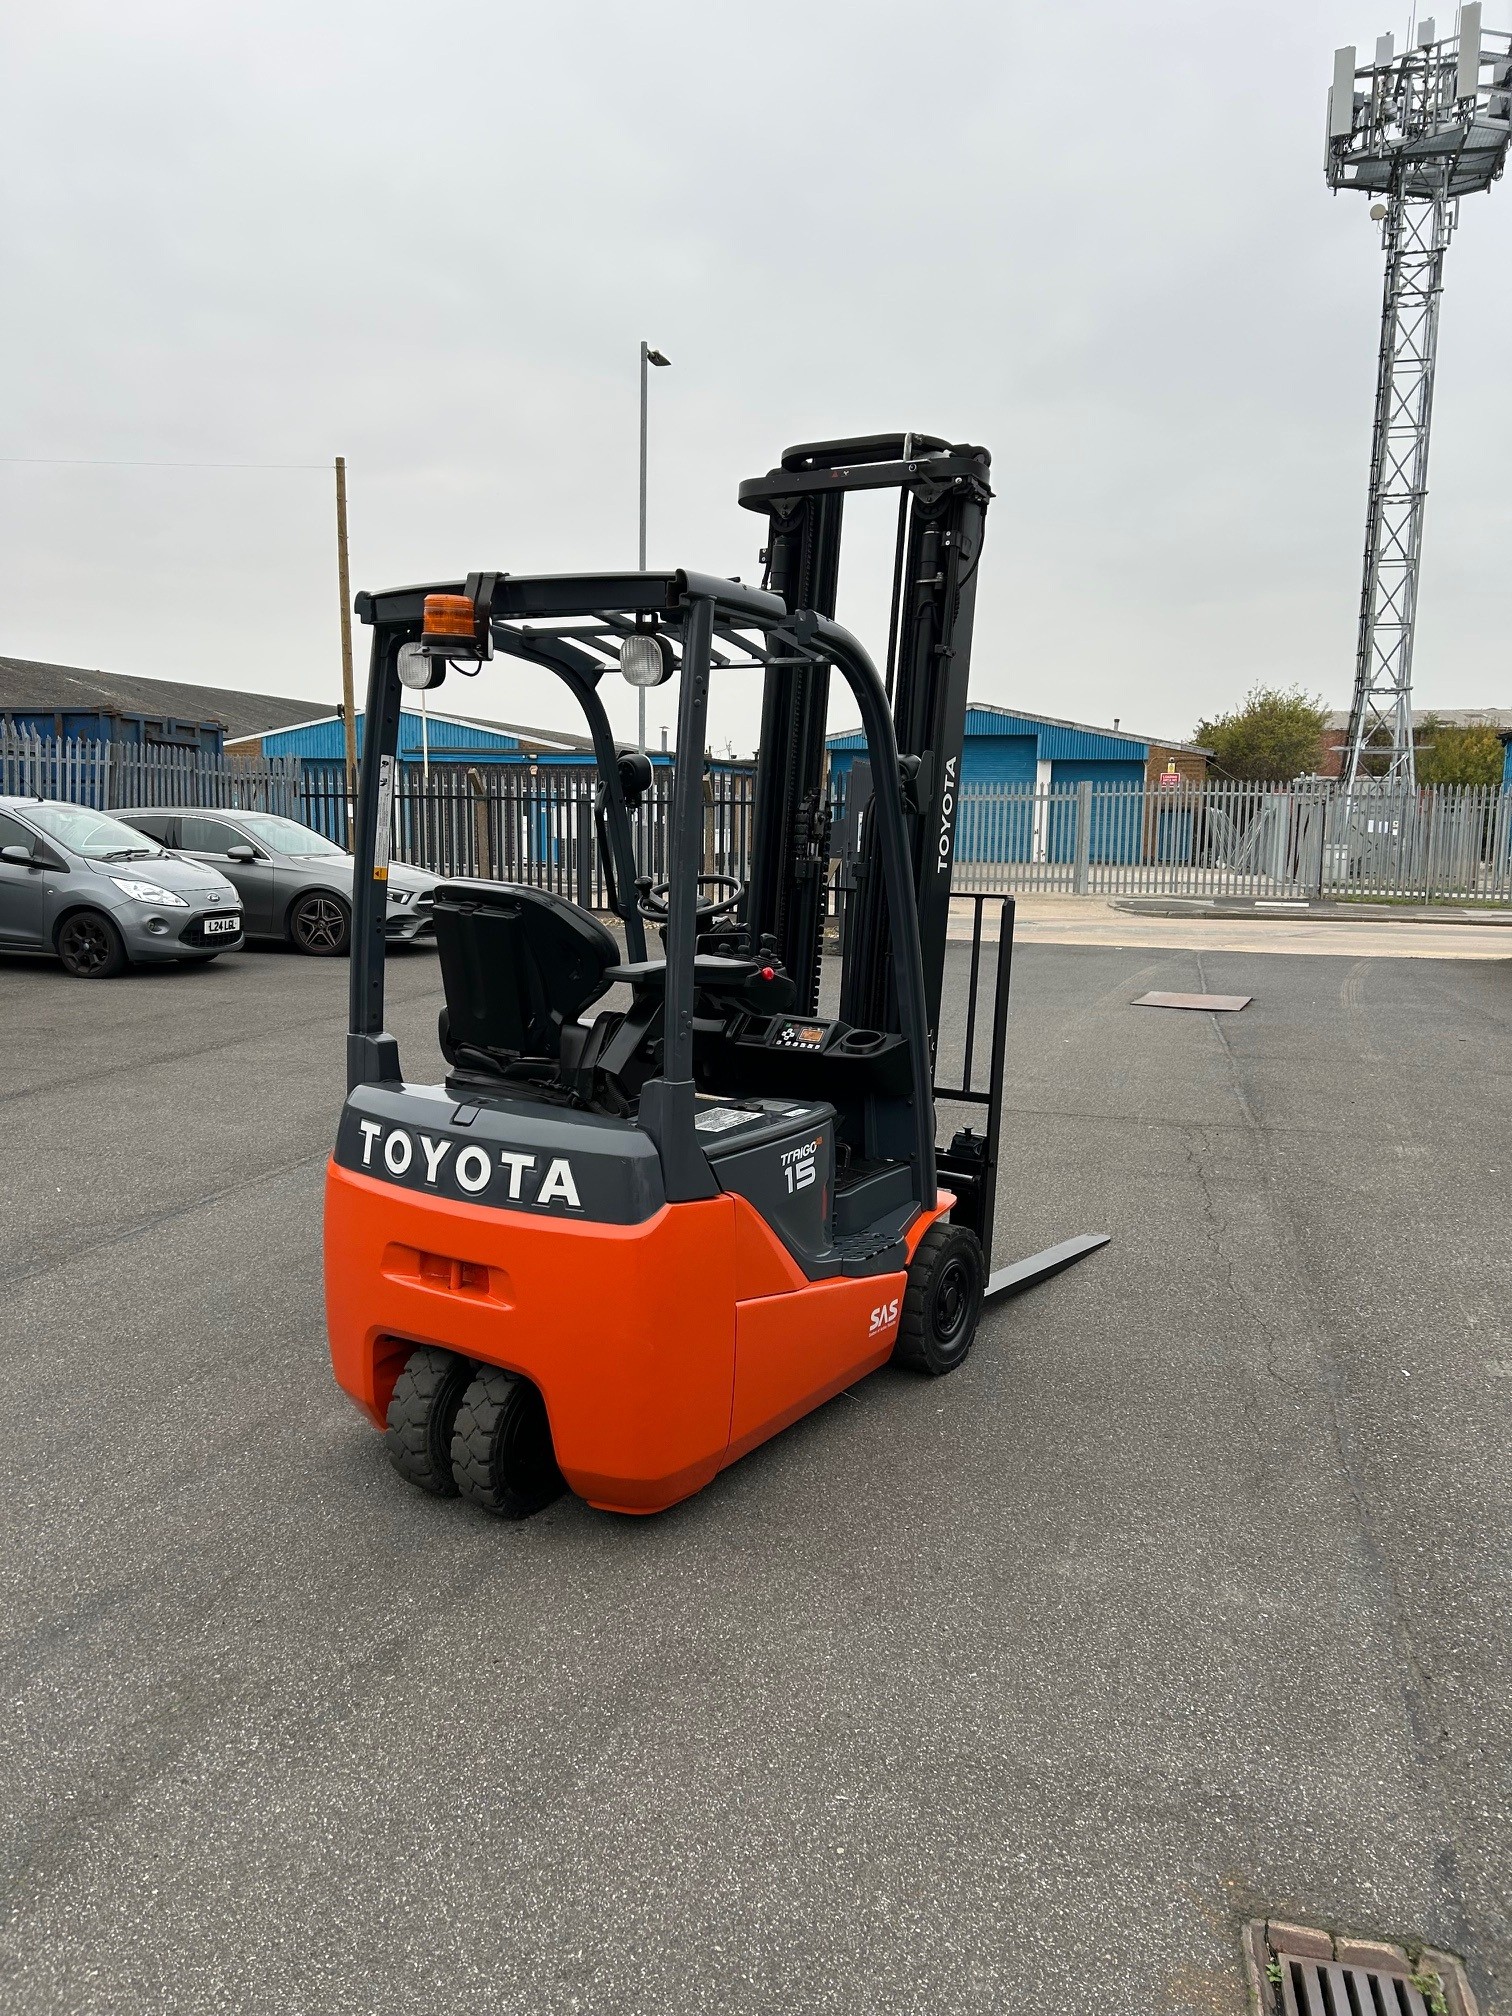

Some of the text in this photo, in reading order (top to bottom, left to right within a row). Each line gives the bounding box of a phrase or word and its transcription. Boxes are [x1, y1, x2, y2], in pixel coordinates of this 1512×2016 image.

[937, 756, 957, 874] TOYOTA
[209, 920, 224, 932] L24
[359, 1118, 582, 1207] TOYOTA
[784, 1156, 816, 1194] 15
[869, 1298, 899, 1331] SAS
